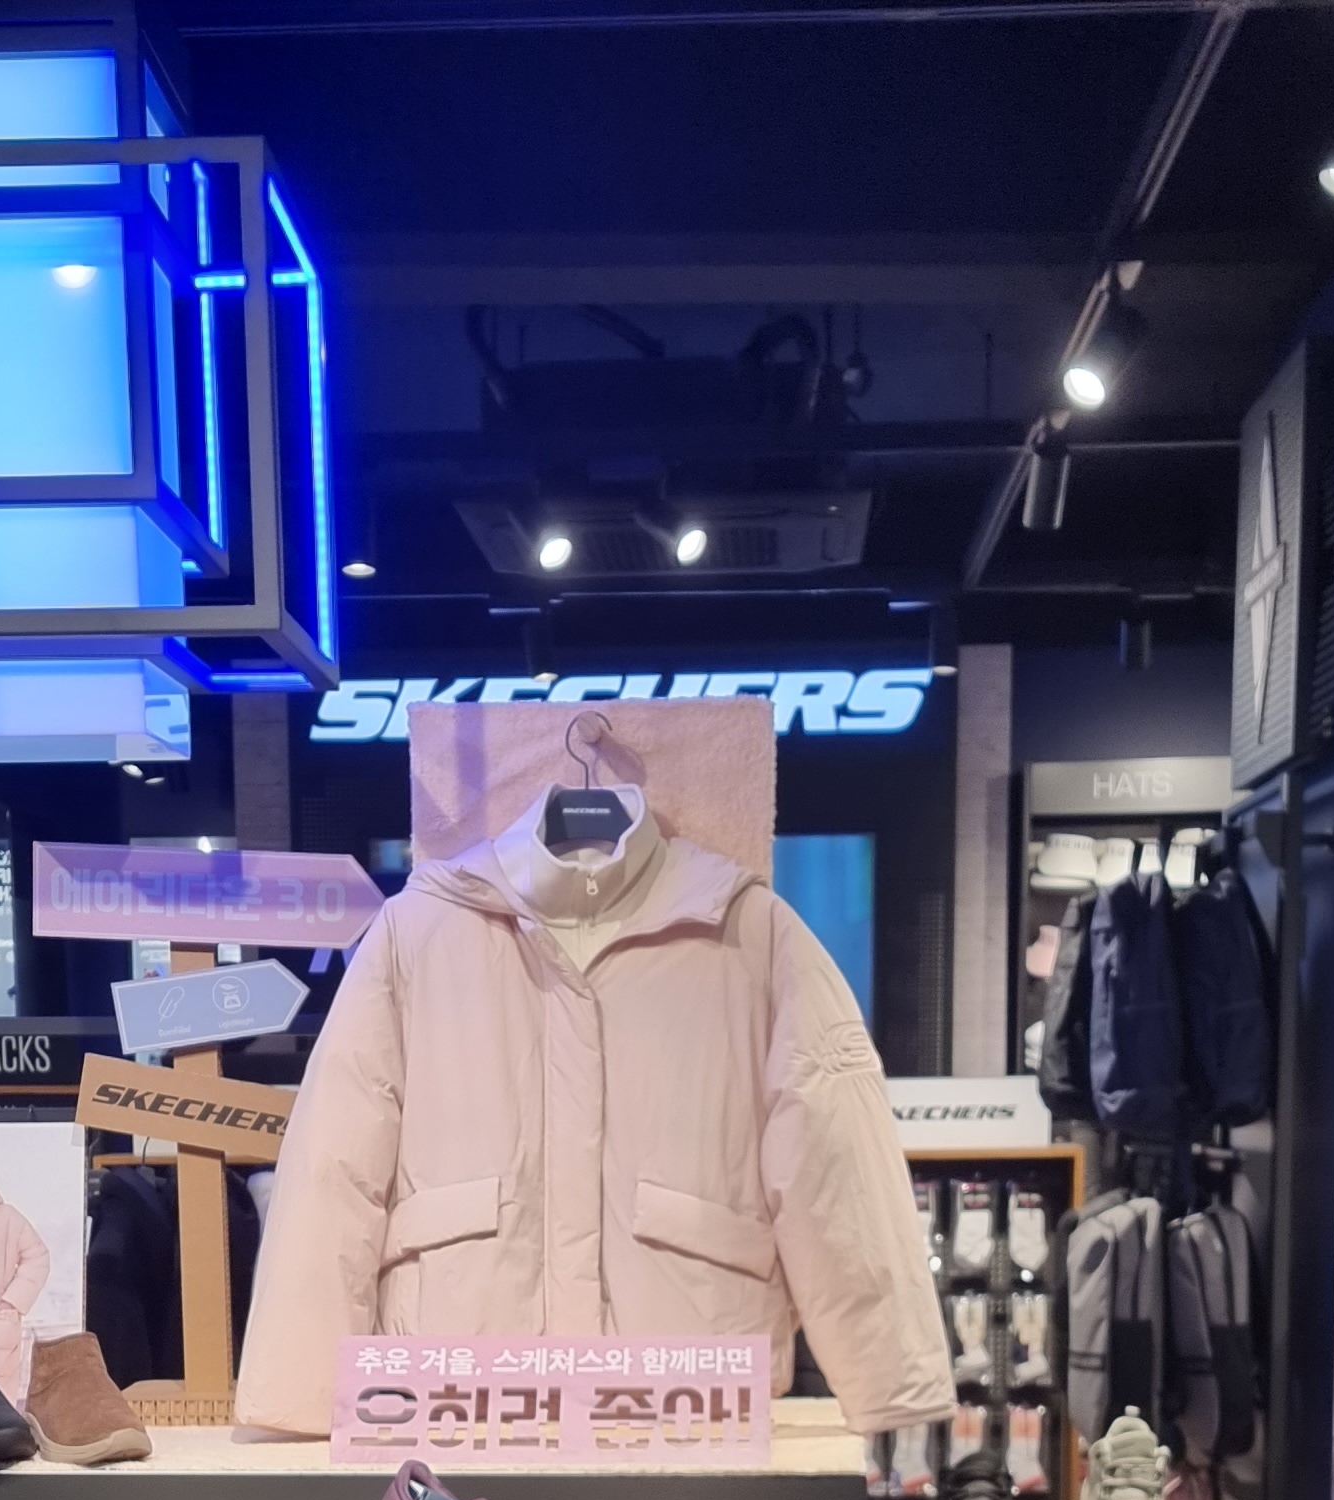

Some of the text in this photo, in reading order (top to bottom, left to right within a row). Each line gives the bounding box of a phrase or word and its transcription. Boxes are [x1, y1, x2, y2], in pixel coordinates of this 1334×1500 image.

[1093, 771, 1173, 799] HATS
[50, 866, 347, 924] 에어리다운 3.0
[92, 1083, 289, 1137] SKECHER
[890, 1104, 1017, 1121] KECHERS
[355, 1346, 753, 1377] 추운 겨울, 스케쳐스와 함께라면
[350, 1383, 752, 1450] 오히려 좋아!
